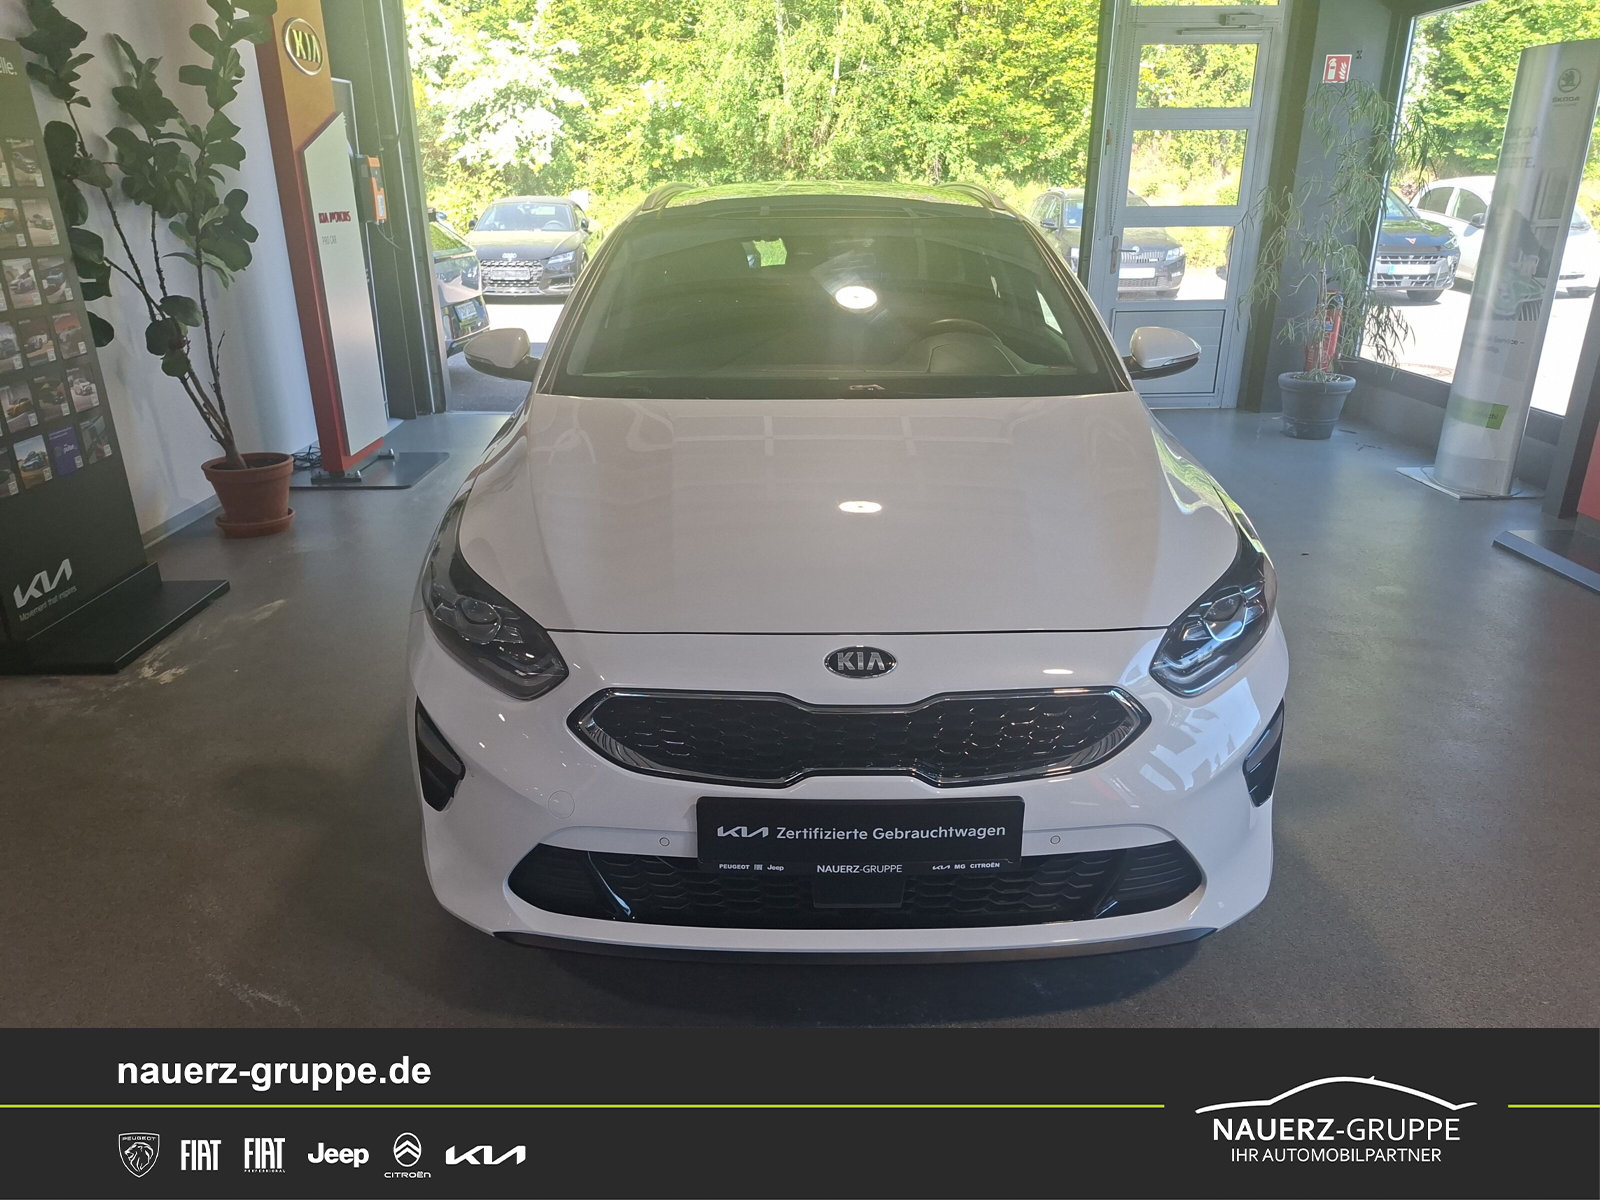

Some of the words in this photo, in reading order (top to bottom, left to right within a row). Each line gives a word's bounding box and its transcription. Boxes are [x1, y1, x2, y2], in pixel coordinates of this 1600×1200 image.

[292, 29, 321, 64] KIA
[13, 558, 73, 609] KIA
[837, 651, 885, 671] KIA
[717, 825, 769, 838] KIA
[776, 826, 868, 840] Zertifizierte
[872, 826, 1006, 840] Gebrauchtwagen
[766, 864, 785, 872] Jeep
[816, 864, 903, 874] NAUERZ-GRUPPE
[969, 861, 1001, 869] CITROËN
